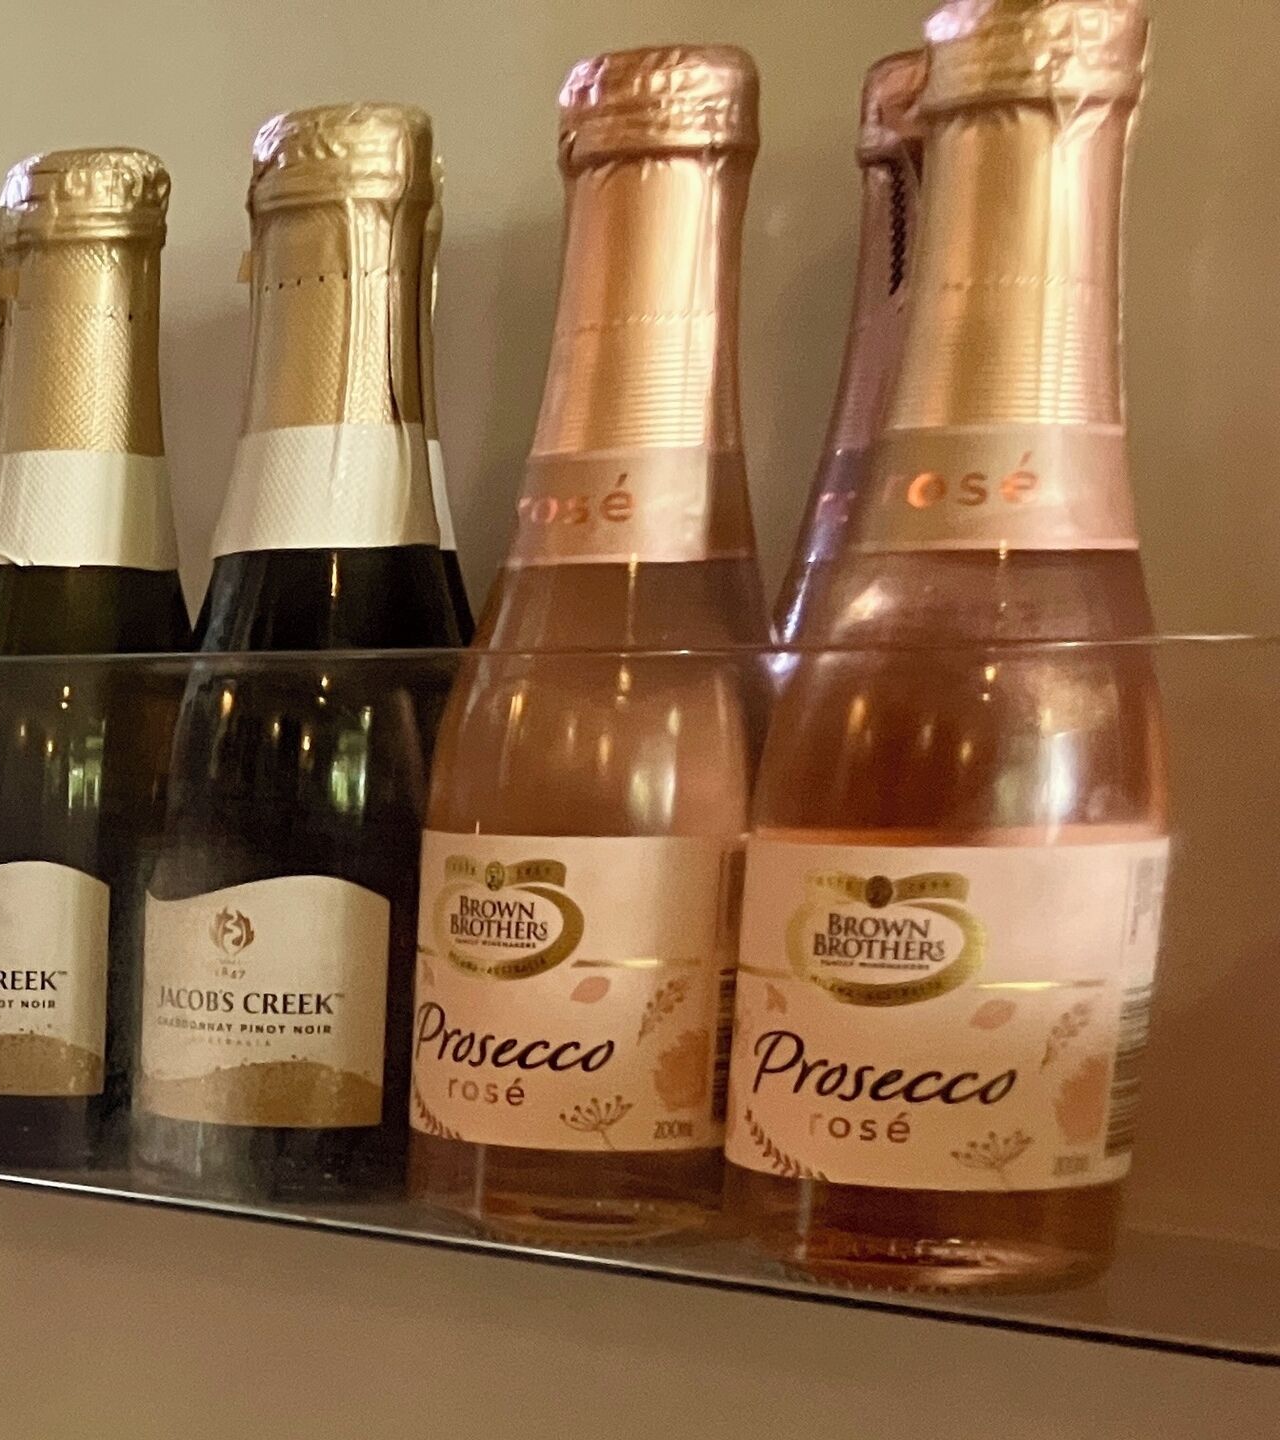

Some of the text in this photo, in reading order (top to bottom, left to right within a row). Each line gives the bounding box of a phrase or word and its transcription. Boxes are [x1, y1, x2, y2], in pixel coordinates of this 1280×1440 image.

[459, 894, 536, 921] BROWN
[449, 912, 549, 942] BROTHERS
[827, 912, 932, 940] BROWN
[811, 932, 946, 963] BROTHERS
[20, 999, 57, 1010] NOIR
[156, 984, 235, 1014] JACOB'S
[240, 1024, 287, 1035] PINOT
[292, 1025, 333, 1035] NOIR
[414, 1001, 616, 1073] Prosecco
[752, 1028, 1019, 1106] Prosecco
[446, 1077, 526, 1108] rosé
[807, 1111, 913, 1145] rosé
